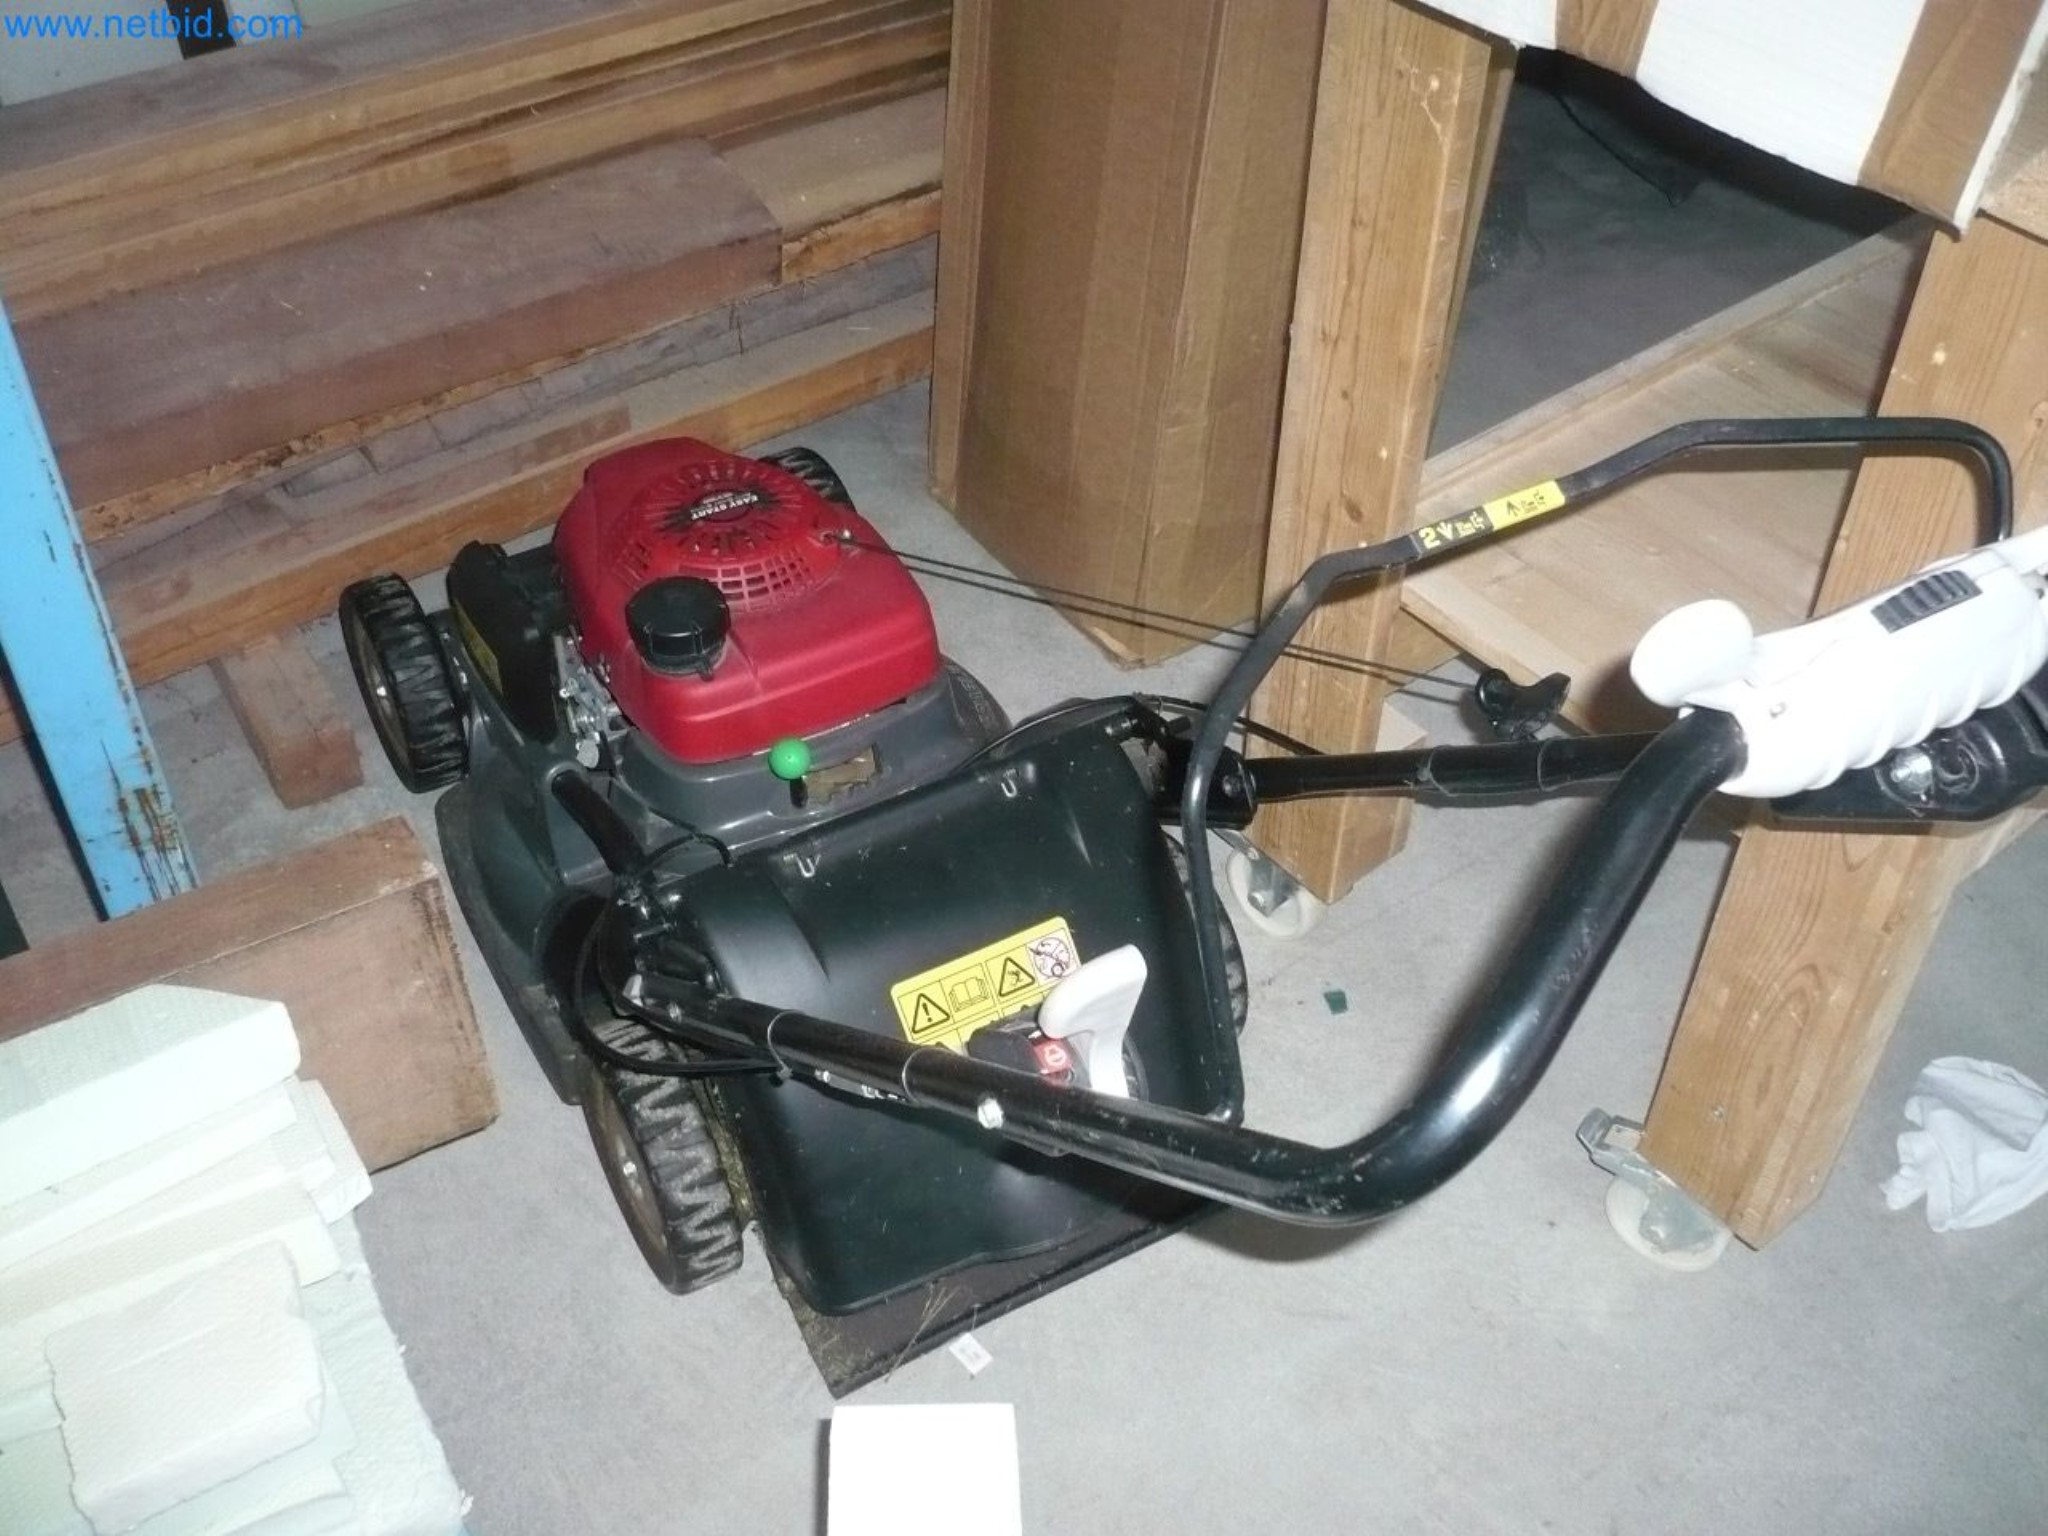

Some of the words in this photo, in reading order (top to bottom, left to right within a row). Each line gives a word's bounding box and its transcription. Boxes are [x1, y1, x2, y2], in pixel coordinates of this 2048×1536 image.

[729, 494, 758, 508] EASY
[691, 503, 727, 520] START
[1418, 527, 1441, 549] 2
